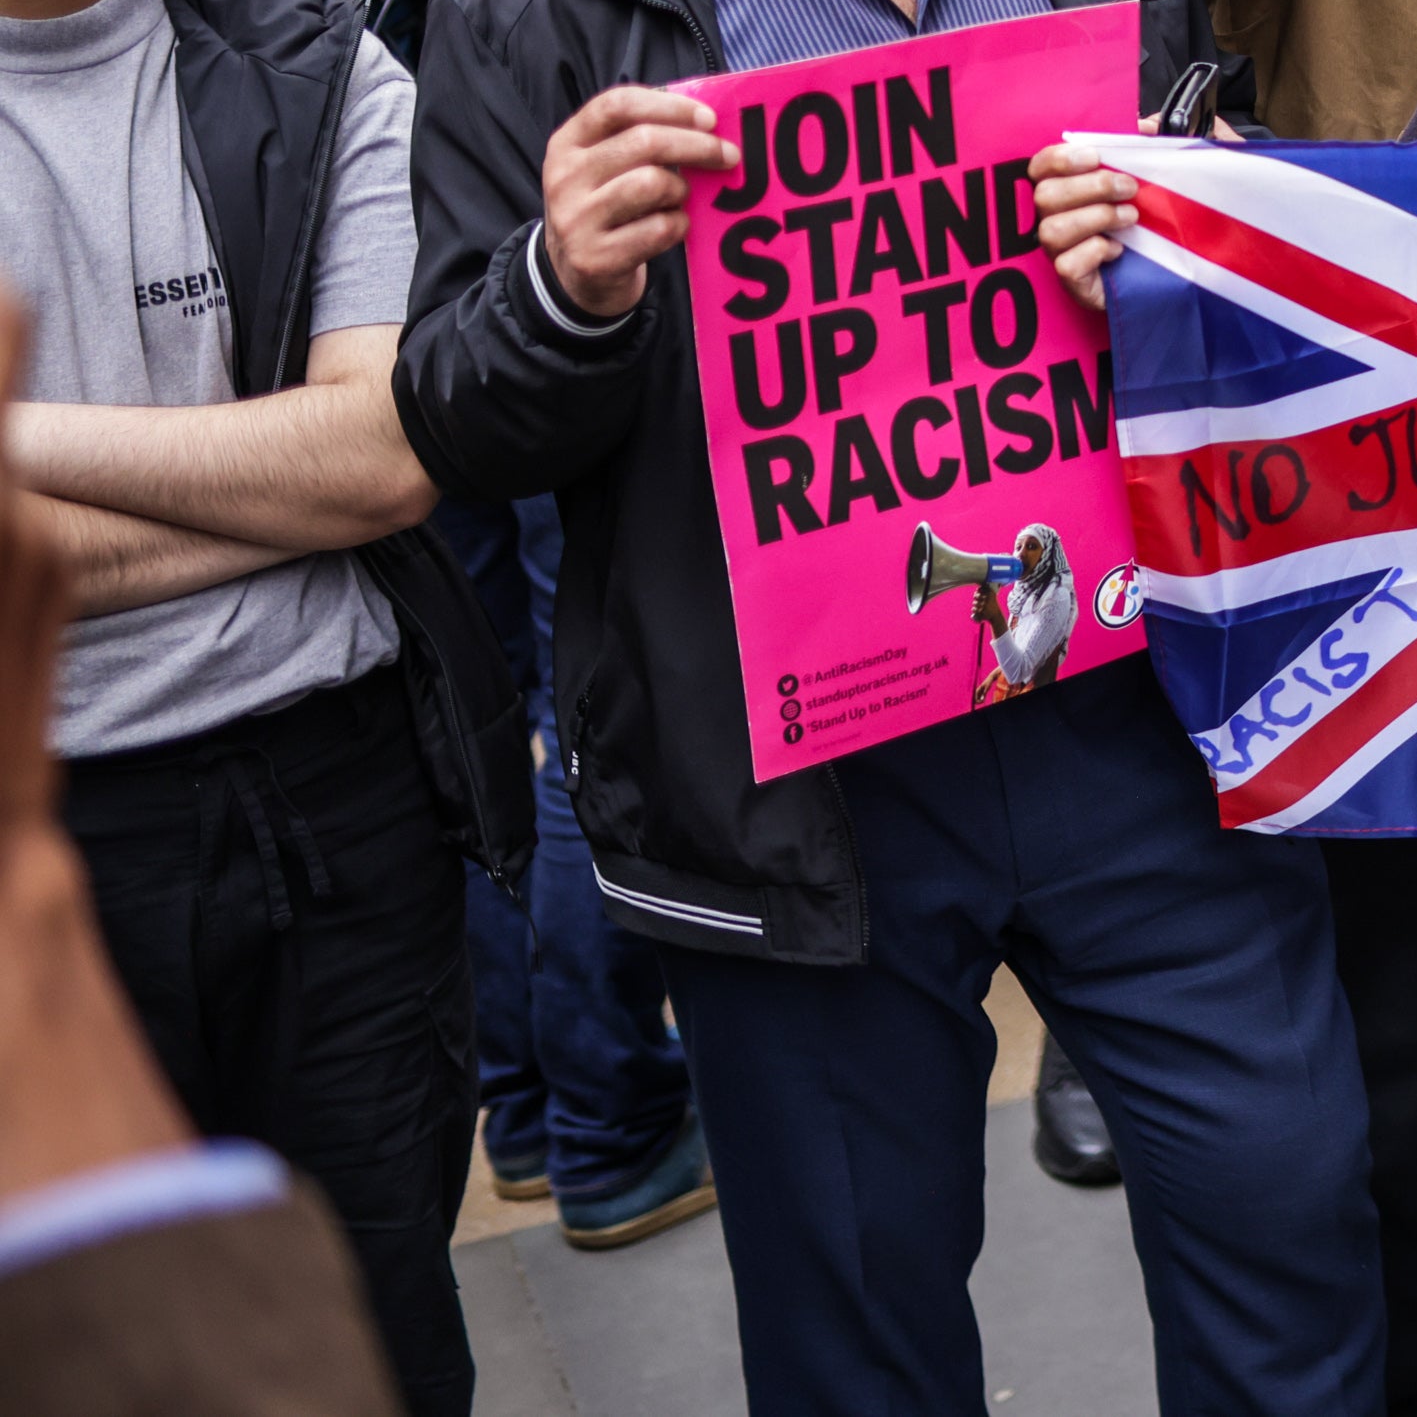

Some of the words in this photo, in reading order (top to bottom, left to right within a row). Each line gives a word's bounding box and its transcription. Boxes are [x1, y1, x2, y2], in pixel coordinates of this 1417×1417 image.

[712, 65, 958, 213] JOIN
[719, 156, 1039, 322] STAND
[728, 307, 878, 430] UP
[902, 266, 1039, 385] TO
[1179, 443, 1310, 557] NO
[803, 647, 908, 686] @AntiRacismDay
[806, 655, 949, 711] standuptoracism.org.uk
[849, 707, 866, 721] Up
[869, 703, 881, 714] to
